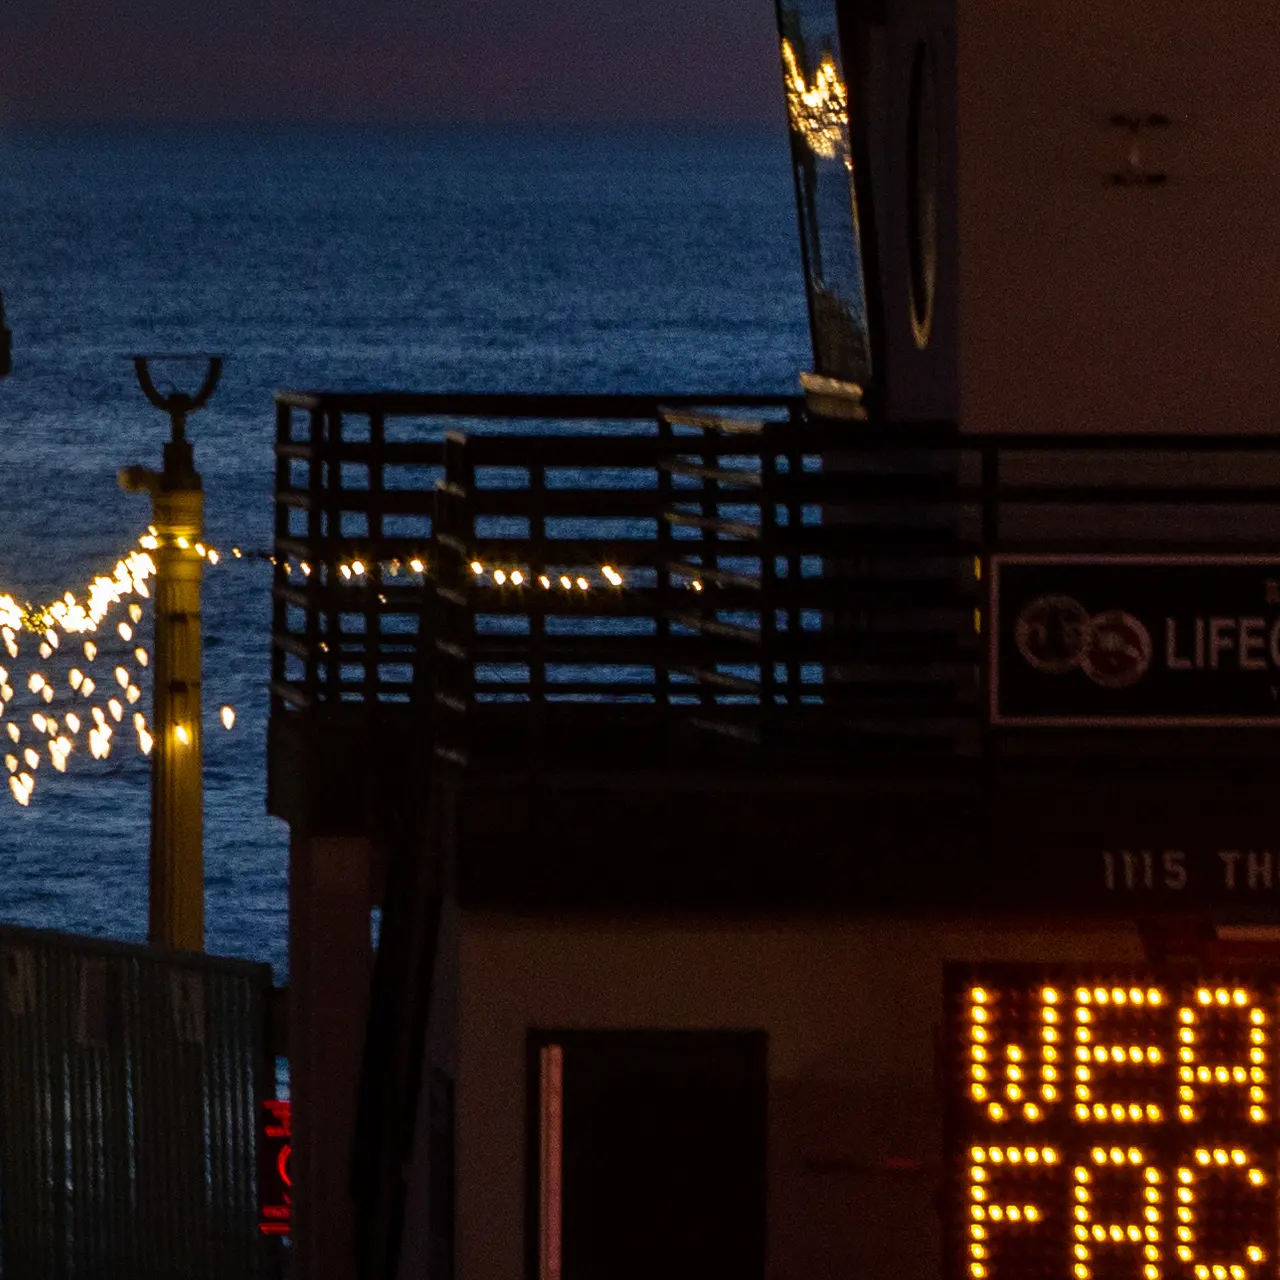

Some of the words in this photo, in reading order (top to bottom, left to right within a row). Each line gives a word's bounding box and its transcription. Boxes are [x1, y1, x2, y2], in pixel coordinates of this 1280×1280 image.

[1164, 614, 1280, 671] LIFE
[1101, 847, 1188, 891] 1115
[1216, 847, 1280, 892] TH
[970, 985, 1268, 1124] WEA
